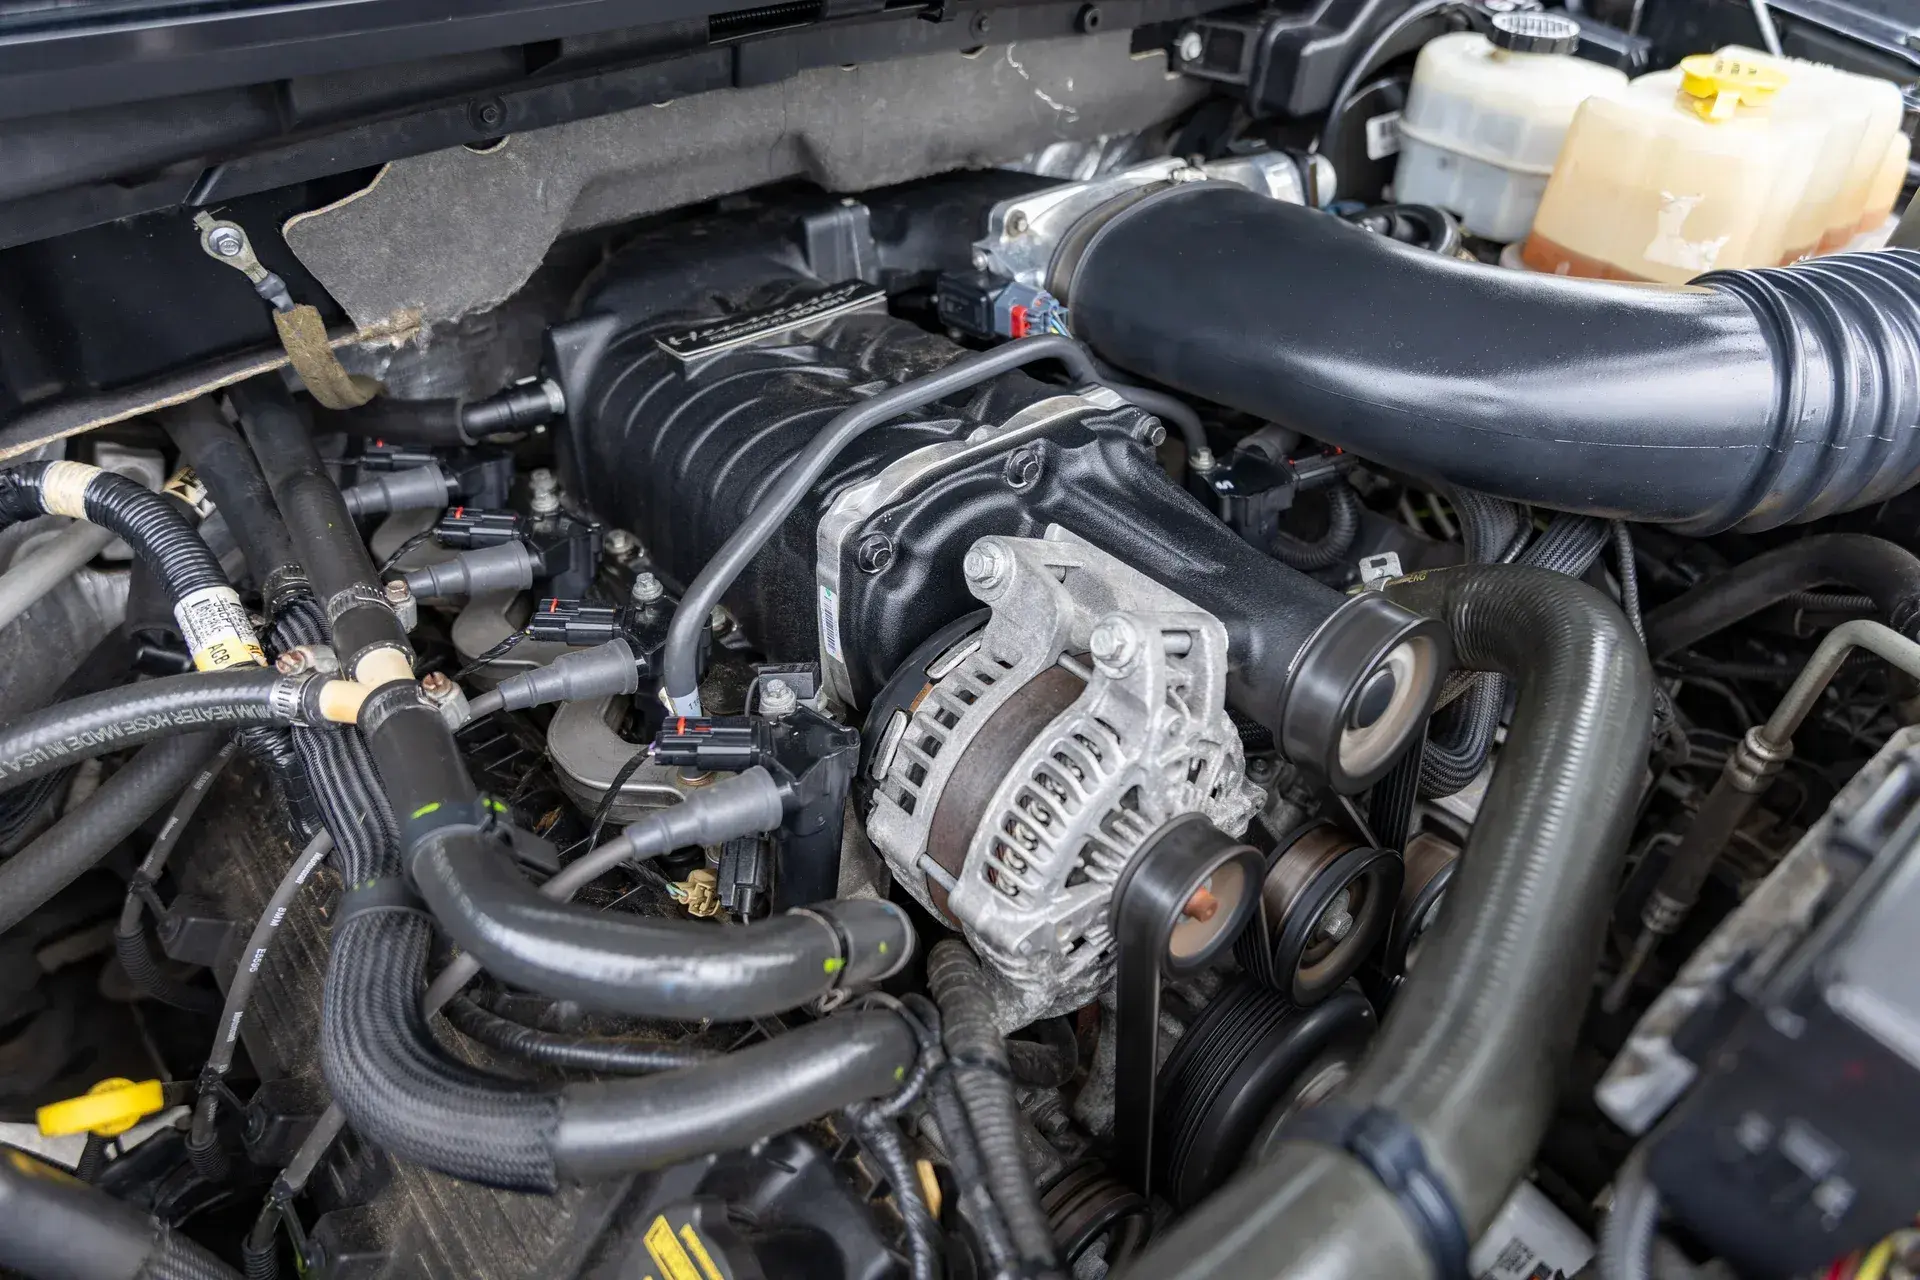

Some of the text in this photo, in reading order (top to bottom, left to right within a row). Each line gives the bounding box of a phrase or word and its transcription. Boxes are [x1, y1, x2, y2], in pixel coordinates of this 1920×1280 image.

[122, 711, 173, 735] HOSE
[170, 704, 235, 725] HEATER
[65, 721, 125, 752] MADE
[45, 740, 70, 758] IN
[295, 851, 324, 884] Motorcraft
[269, 907, 287, 927] 8MM
